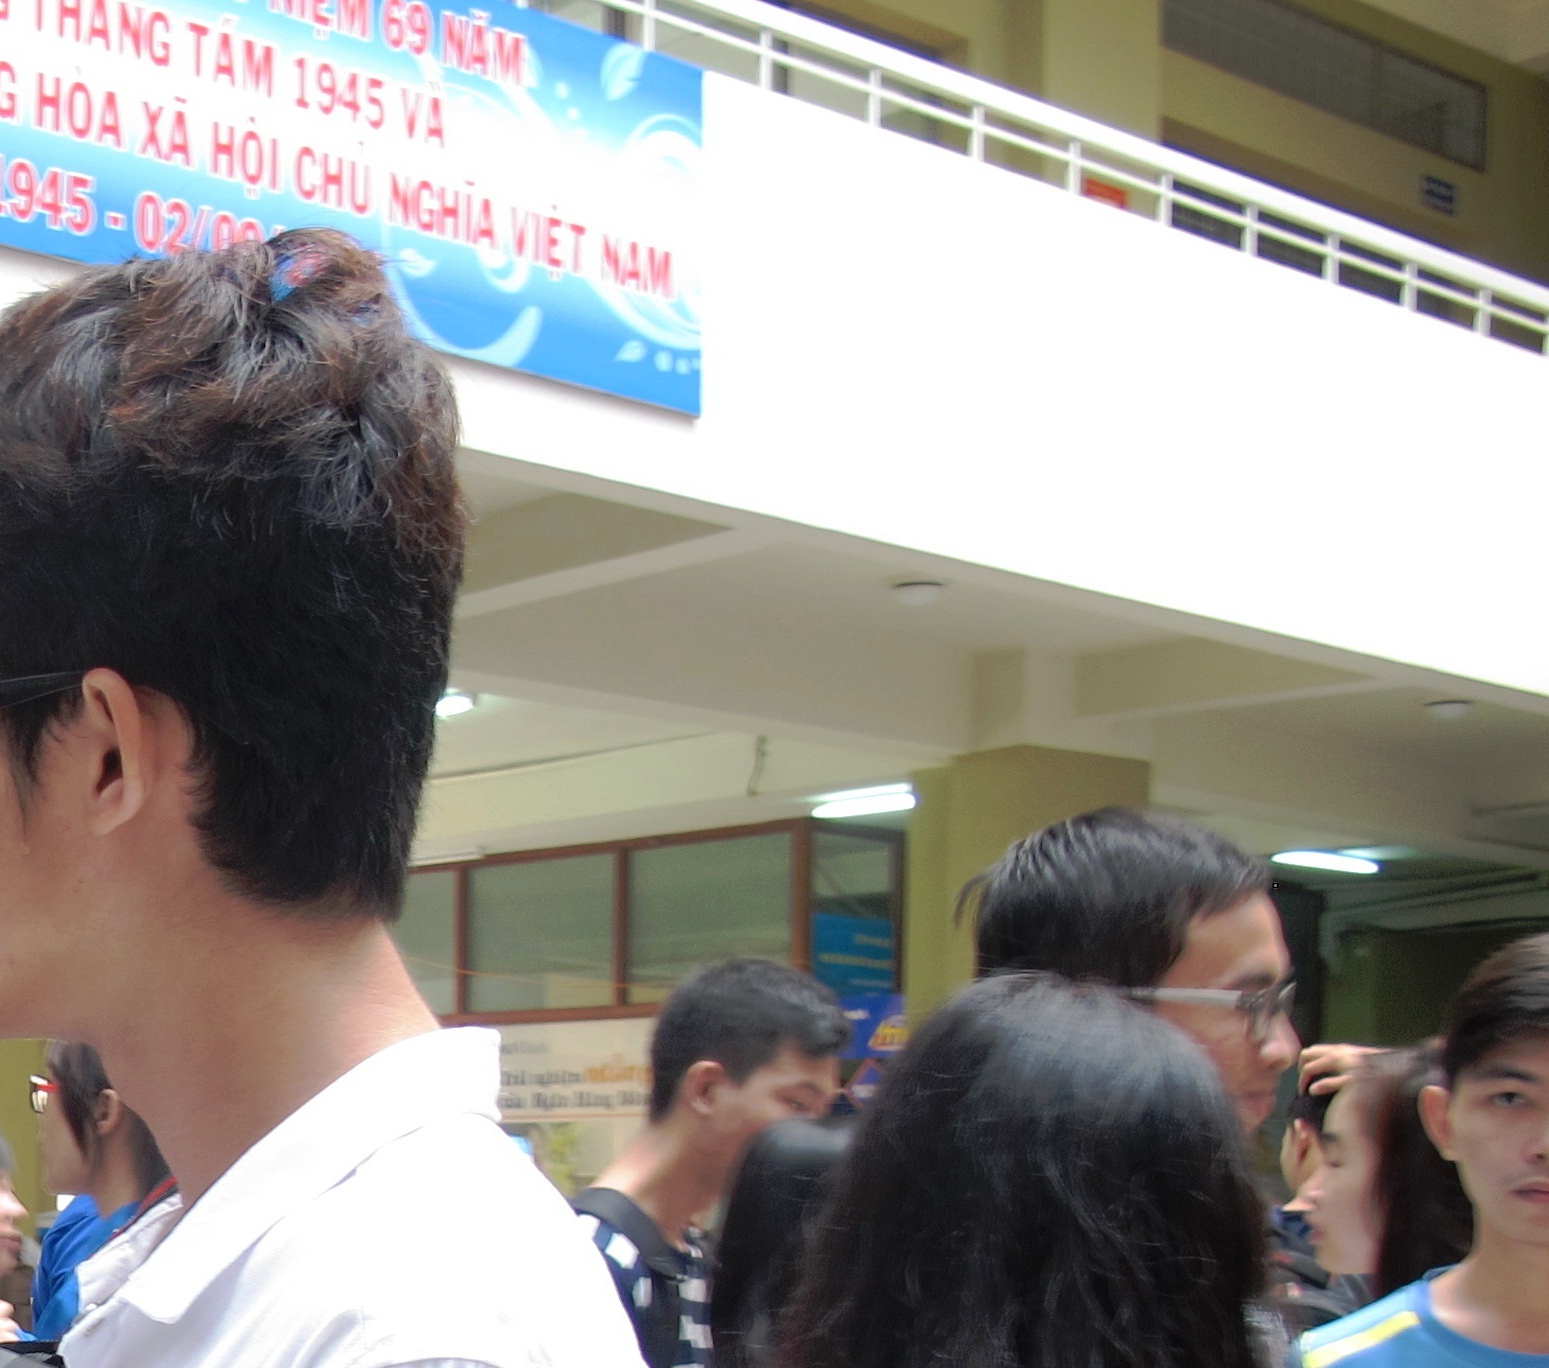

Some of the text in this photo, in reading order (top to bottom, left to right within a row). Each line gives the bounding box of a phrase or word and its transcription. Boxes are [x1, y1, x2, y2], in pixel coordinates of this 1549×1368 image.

[189, 17, 274, 99] TÁM
[294, 56, 385, 130] 1945
[384, 0, 431, 55] 69
[443, 8, 526, 87] NĂM
[140, 96, 193, 168] XÃ
[600, 233, 674, 300] NAM
